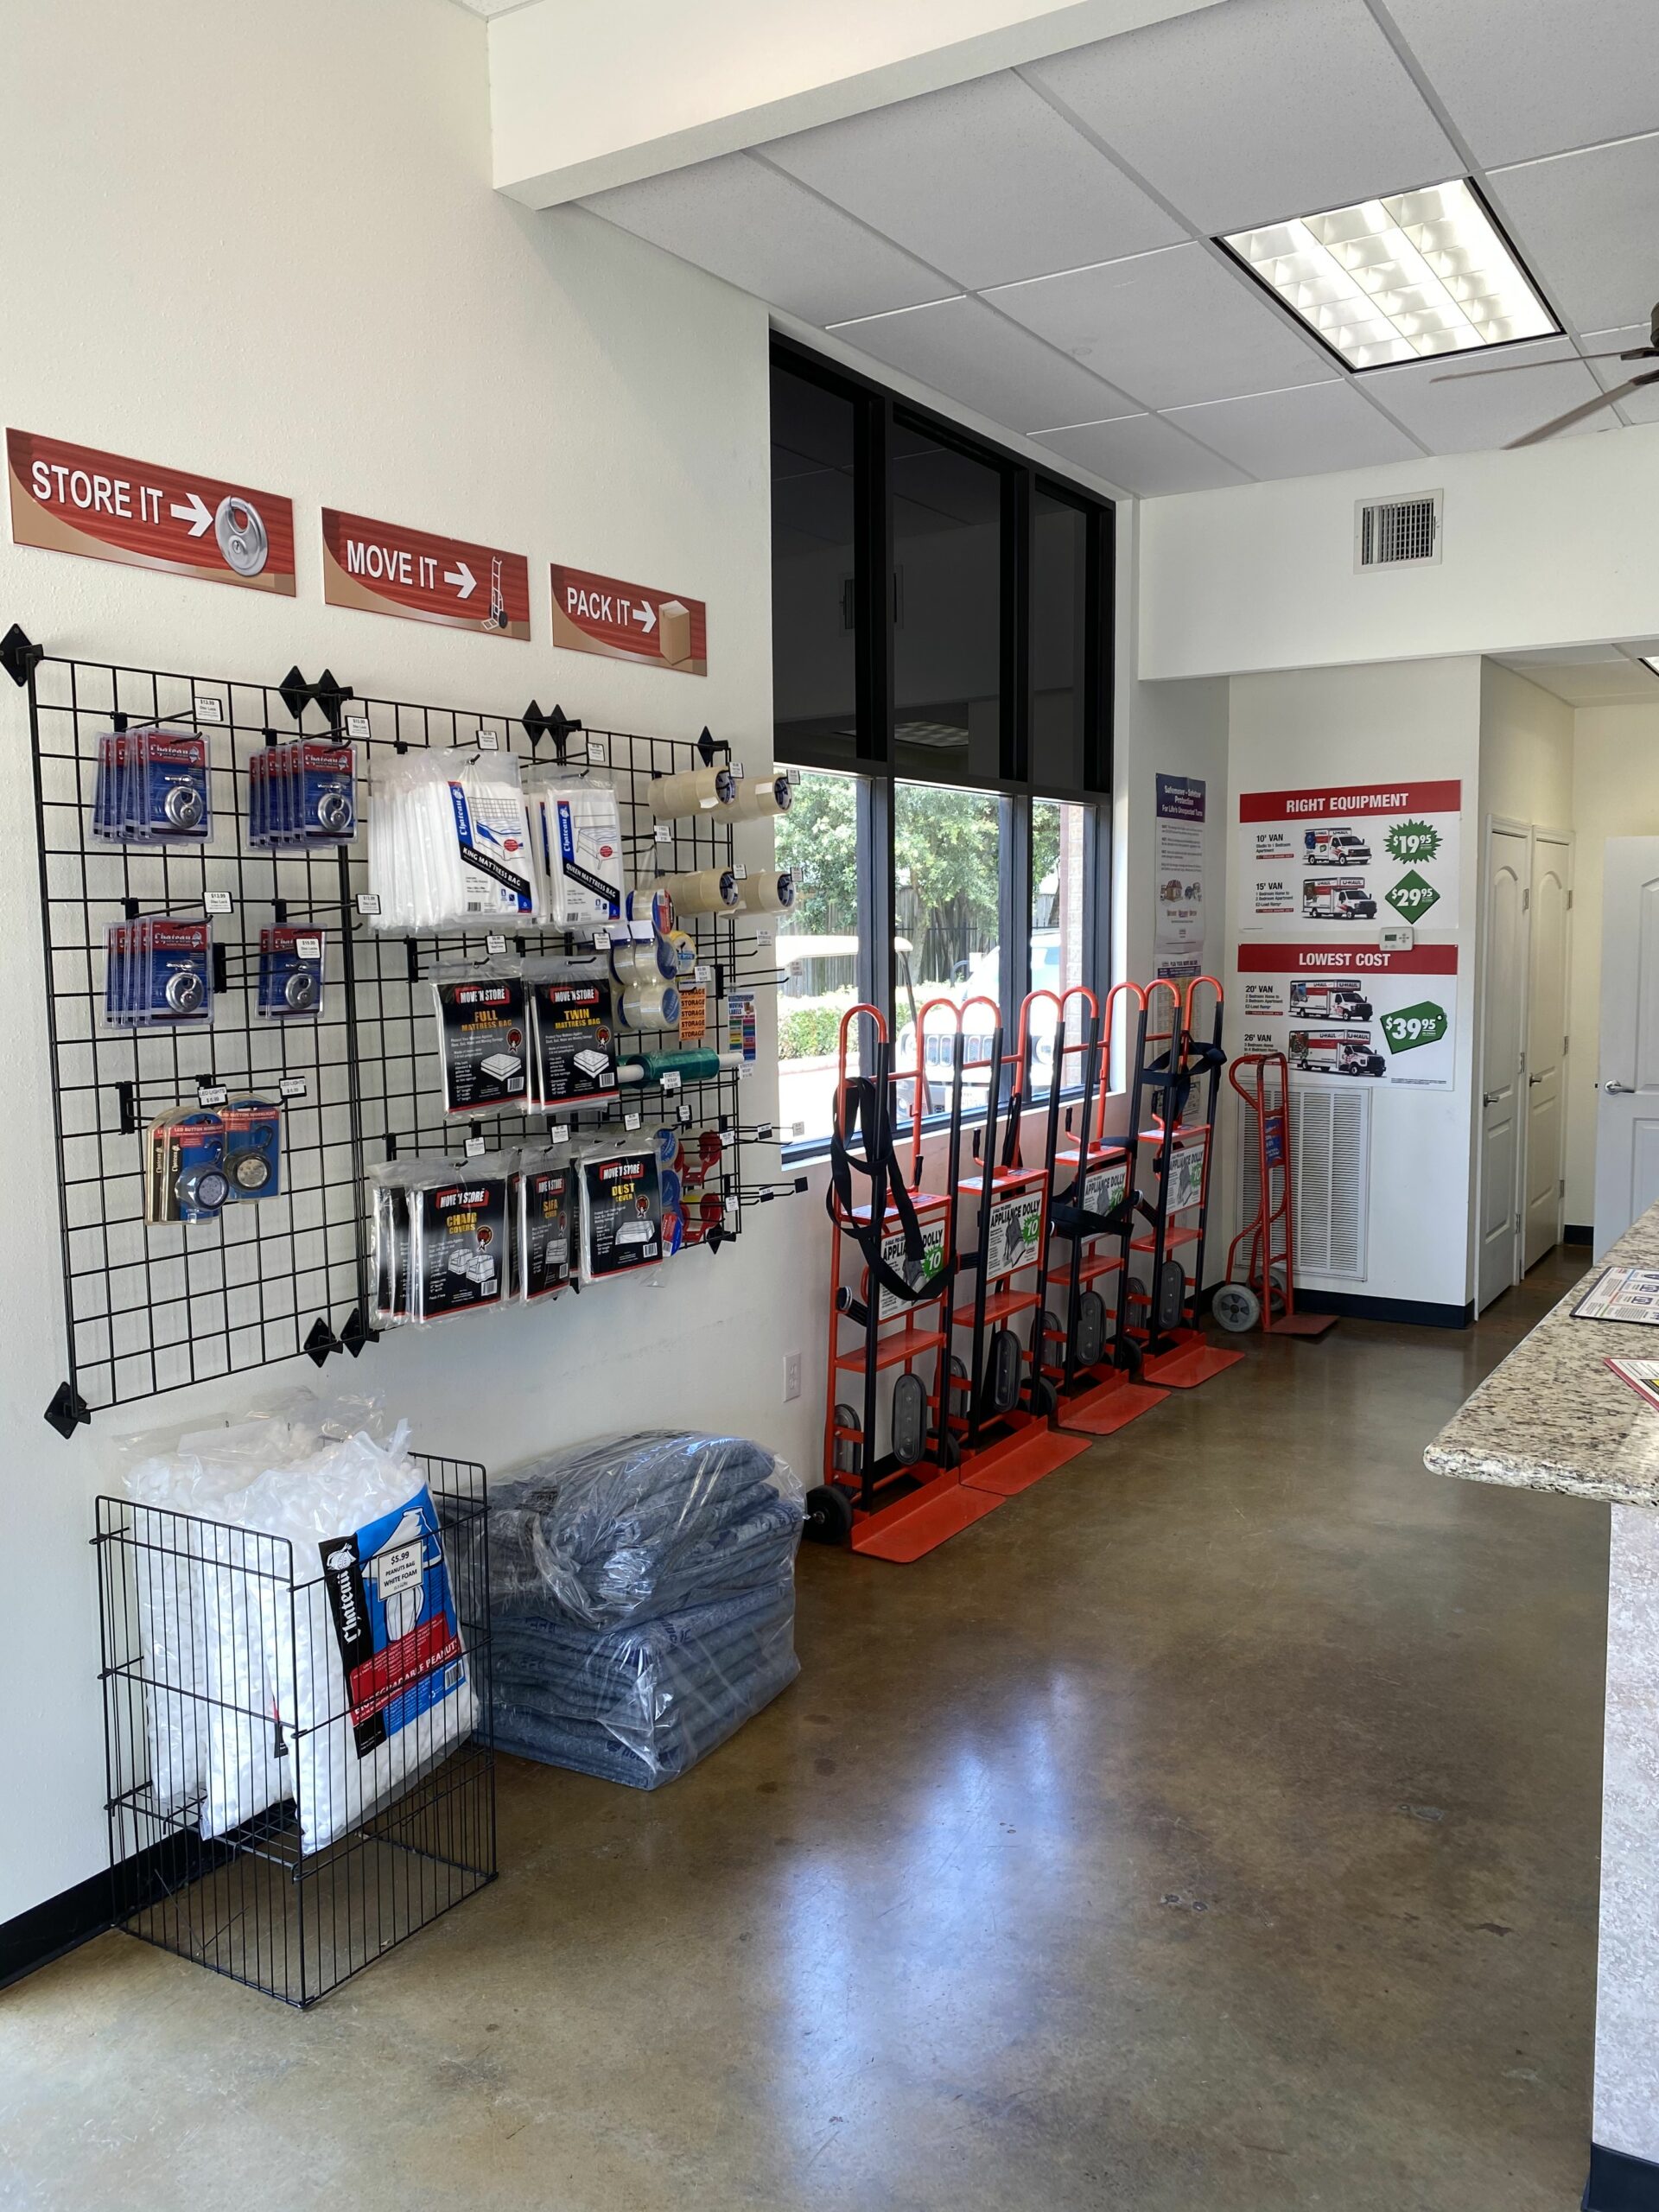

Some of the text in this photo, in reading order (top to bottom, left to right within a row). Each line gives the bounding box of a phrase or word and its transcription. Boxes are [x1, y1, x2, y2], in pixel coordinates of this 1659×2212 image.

[32, 461, 163, 524] STORE IT
[347, 540, 437, 589] MOVE IT
[568, 588, 630, 626] PACK IT
[150, 744, 188, 756] Chateau
[305, 754, 338, 766] Chateau
[1286, 793, 1408, 812] RIGHT EQUIPMENT
[456, 800, 467, 835] Chateau
[463, 847, 520, 886] KING MATTRESS BAG
[566, 863, 615, 898] QUEEN MATTRESS BAG
[155, 933, 190, 944] Chateau
[275, 938, 293, 948] Chat
[1300, 953, 1390, 967] LOWEST COST
[460, 991, 477, 1003] MOVE
[485, 988, 505, 1001] STORE
[555, 991, 570, 1002] MOVE
[576, 989, 594, 1001] STORE
[474, 1010, 498, 1022] FULL
[564, 1008, 589, 1020] TWIN
[461, 1021, 496, 1032] MATTRESS
[556, 1020, 586, 1029] MATTRESS
[624, 1164, 639, 1175] STORE
[1111, 1173, 1125, 1187] DOLLY
[612, 1182, 634, 1196] DUST
[440, 1194, 456, 1208] MOVE
[447, 1212, 477, 1227] CHAIR
[990, 1199, 1040, 1228] APPLIANCE DOLLY
[449, 1224, 475, 1234] COVERS
[1027, 1220, 1038, 1236] 10
[923, 1230, 943, 1247] DOLLY
[929, 1251, 941, 1270] 10
[391, 1551, 409, 1565] $5.99
[384, 1575, 400, 1586] WHITE
[402, 1569, 417, 1580] FOAM
[385, 1565, 405, 1576] PEANUTS
[337, 1570, 362, 1644] Chateau
